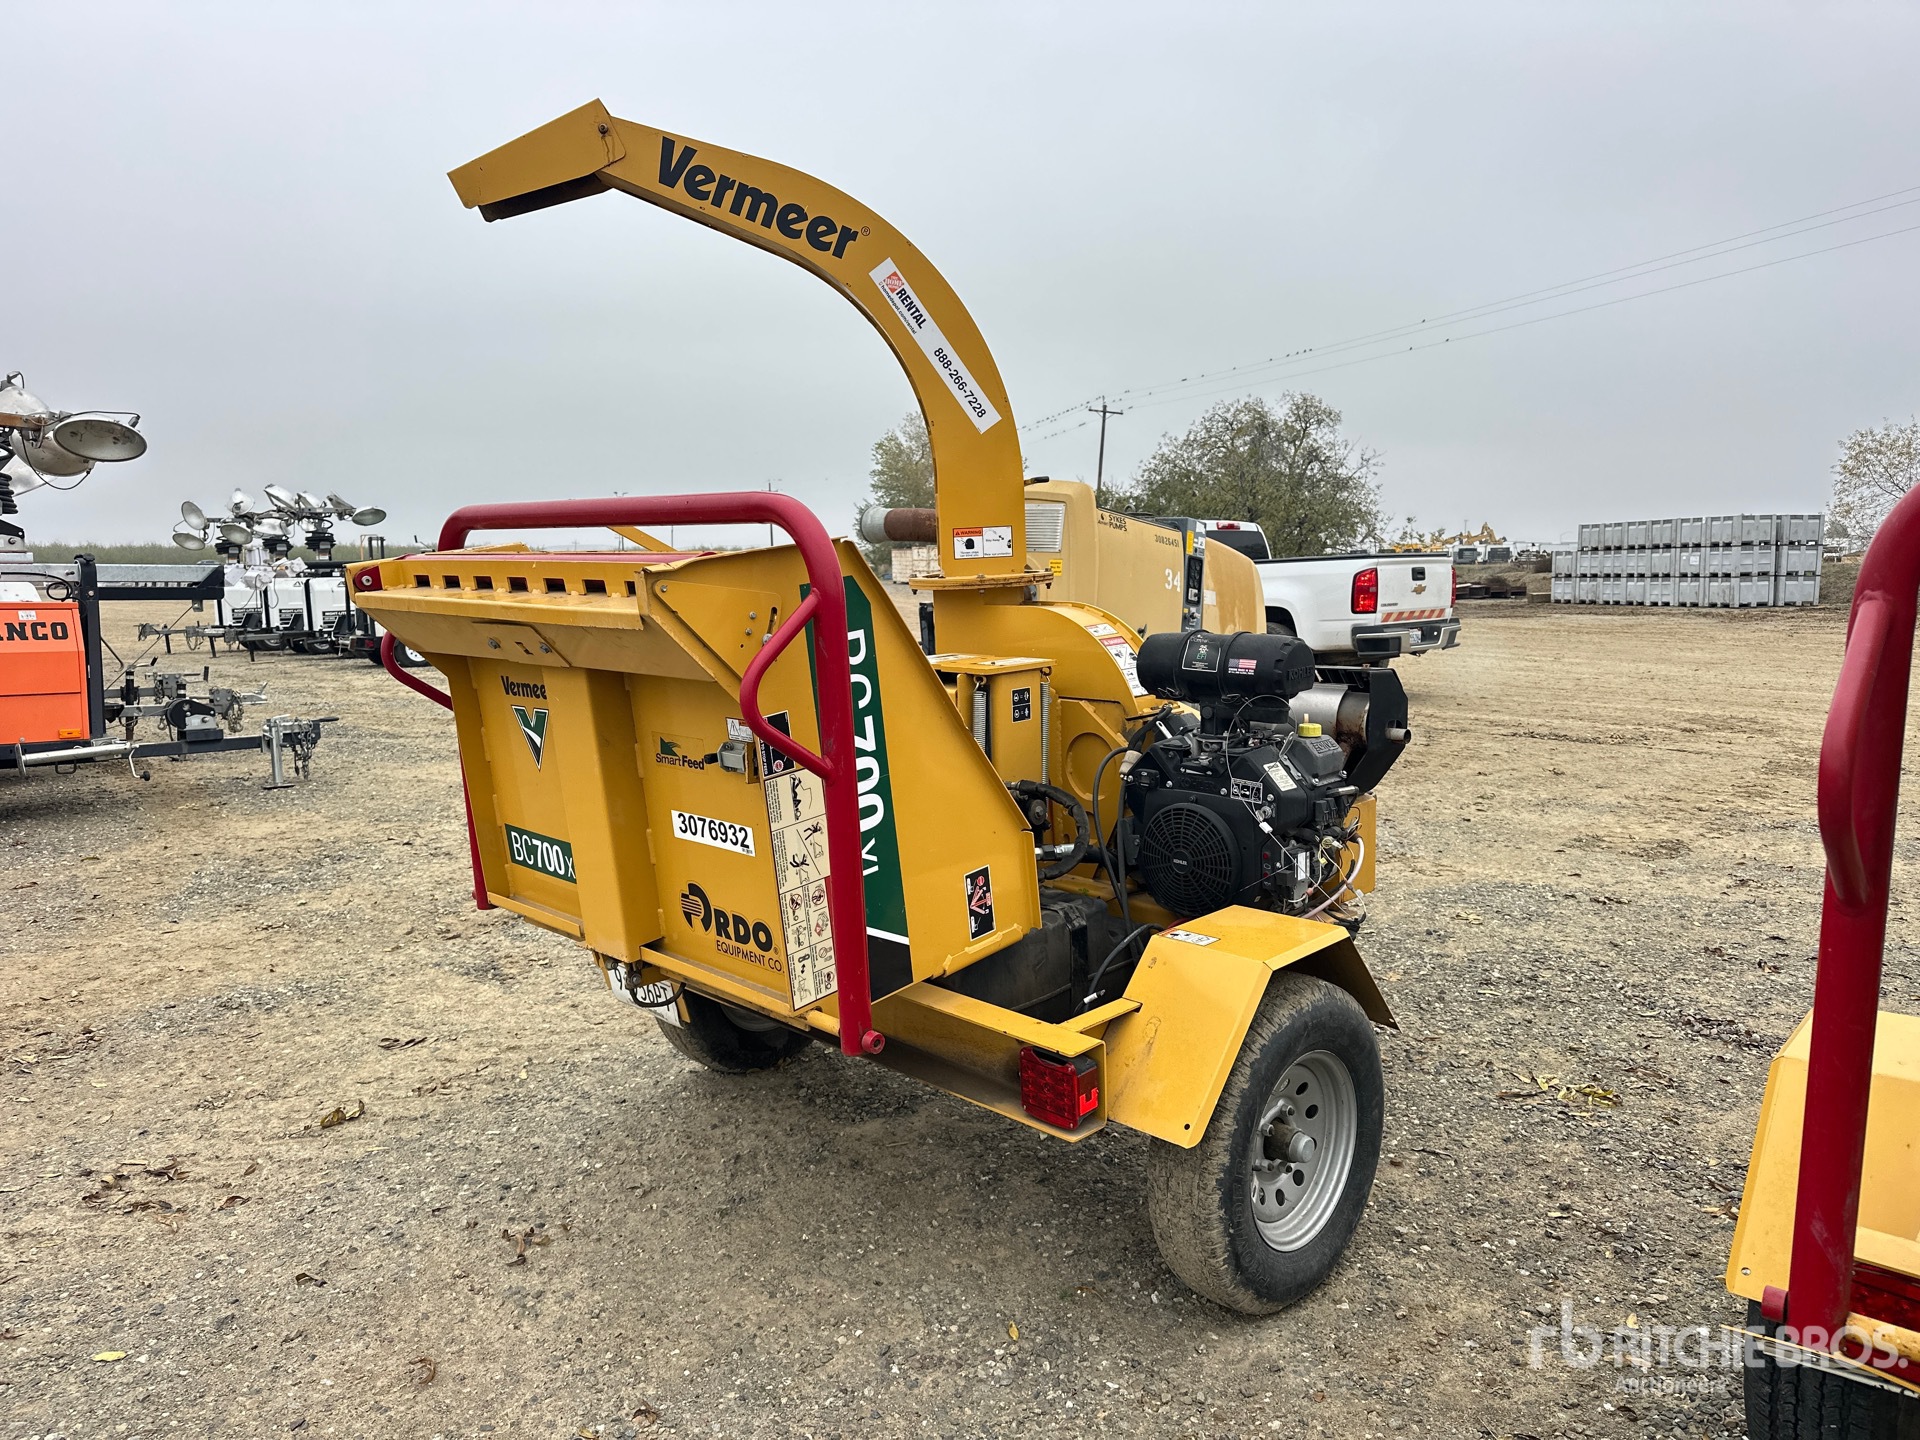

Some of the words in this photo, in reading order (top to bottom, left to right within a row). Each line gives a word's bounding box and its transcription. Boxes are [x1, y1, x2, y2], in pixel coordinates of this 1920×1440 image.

[658, 136, 859, 259] Vermeer
[896, 288, 927, 329] RENTAL
[934, 348, 986, 418] 888-266-7228
[1109, 515, 1126, 525] SYKES
[0, 622, 68, 641] NCO
[655, 753, 705, 771] SmartFeed
[677, 813, 750, 849] 3076932
[716, 939, 766, 967] EQUIPMENT
[768, 957, 785, 974] CO.
